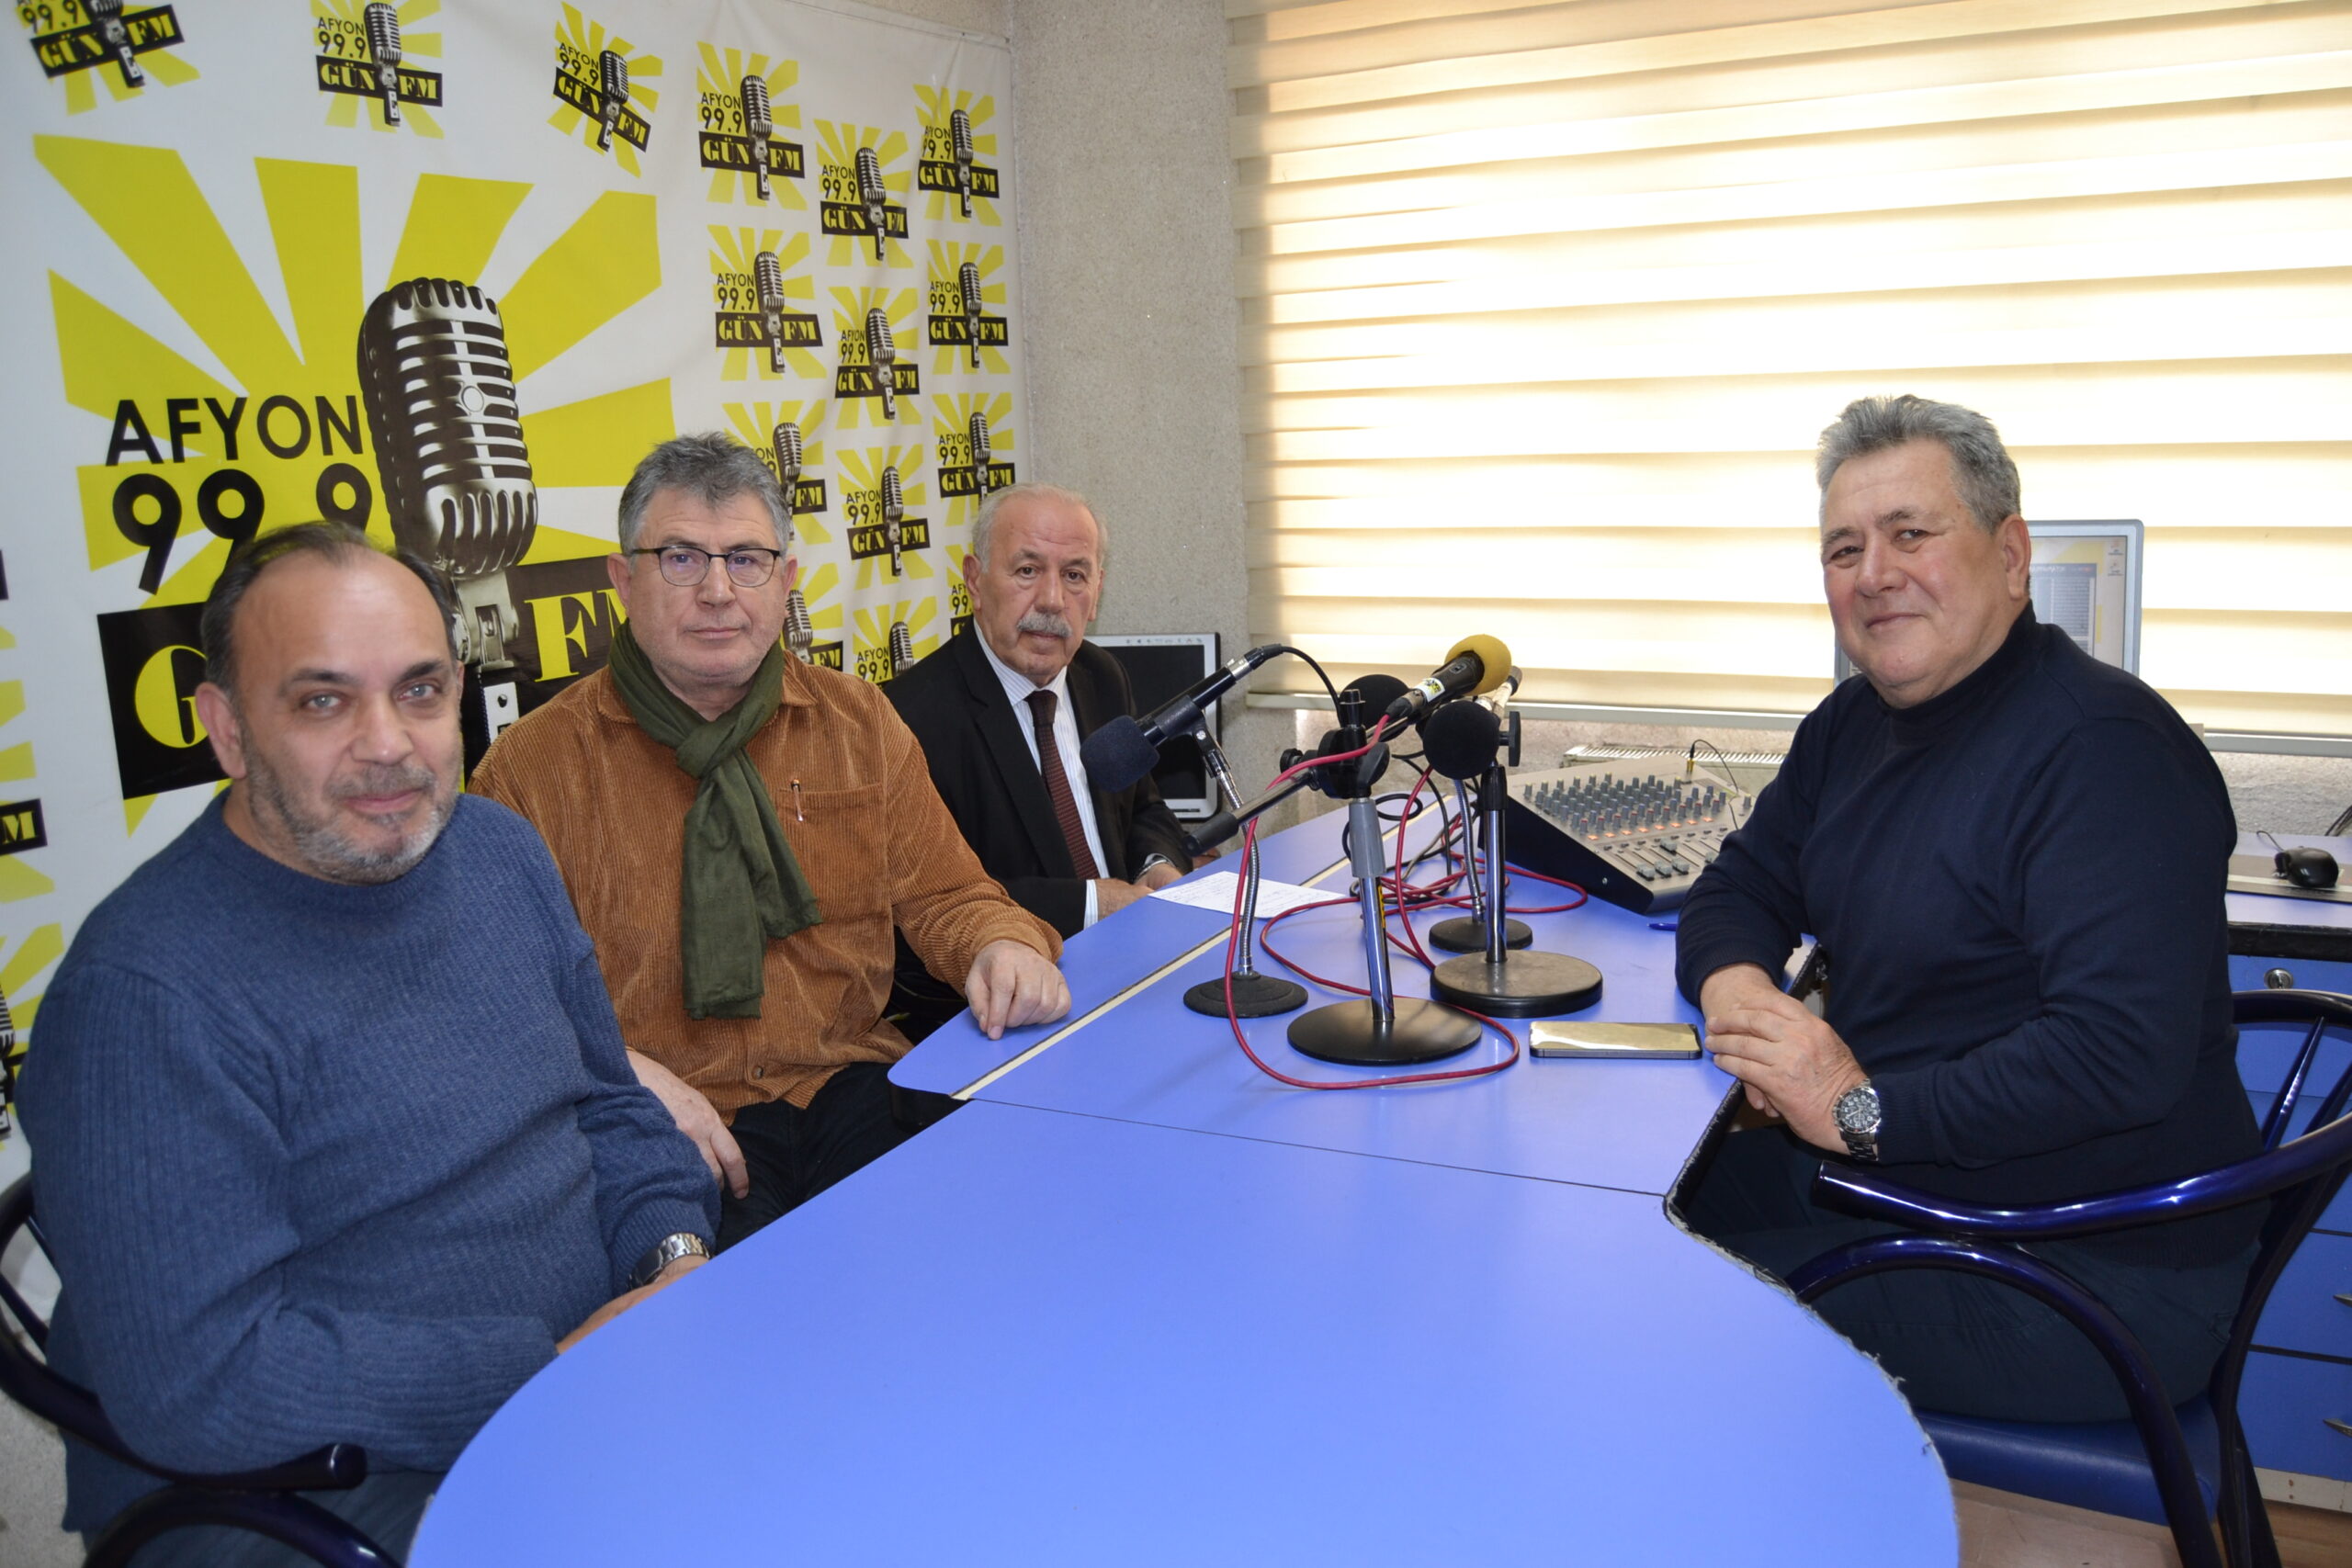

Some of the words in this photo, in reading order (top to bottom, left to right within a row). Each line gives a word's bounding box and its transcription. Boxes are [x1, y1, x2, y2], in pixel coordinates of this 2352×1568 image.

[22, 0, 80, 35] 99.9
[317, 17, 366, 37] AFYON
[40, 32, 105, 69] GÜN
[127, 14, 176, 47] FM
[318, 30, 367, 60] 99.9
[560, 42, 599, 72] AFYON
[560, 52, 600, 86] 99.9
[321, 62, 376, 91] GÜN
[399, 74, 439, 100] FM
[558, 75, 604, 115] GÜN
[616, 112, 648, 145] FM
[700, 92, 741, 110] AFYON
[701, 106, 742, 134] 99.9
[702, 136, 751, 165] GÜN
[769, 147, 801, 172] FM
[822, 164, 856, 180] AFYON
[919, 163, 956, 188] GÜN
[971, 171, 997, 193] FM
[822, 177, 856, 202] 99.9
[823, 205, 866, 230] GÜN
[717, 273, 755, 288] AFYON
[930, 280, 960, 293] AFYON
[718, 287, 756, 311] 99.9
[930, 293, 961, 314] 99.9
[718, 315, 763, 342] GÜN
[782, 320, 818, 341] FM
[841, 329, 865, 342] AFYON
[930, 317, 967, 340] GÜN
[979, 322, 1005, 341] FM
[841, 342, 865, 364] 99.9
[837, 367, 874, 392] GÜN
[894, 369, 917, 389] FM
[106, 395, 364, 467] AFYON
[938, 433, 970, 446] AFYON
[939, 445, 971, 467] 99.9
[941, 468, 975, 492] GÜN
[988, 468, 1012, 488] FM
[795, 485, 824, 508] FM
[846, 489, 882, 505] AFYON
[847, 502, 881, 526] 99.9
[852, 527, 886, 554] GÜN
[901, 524, 927, 546] FM
[952, 594, 972, 615] 99.
[856, 646, 889, 663] AFYON
